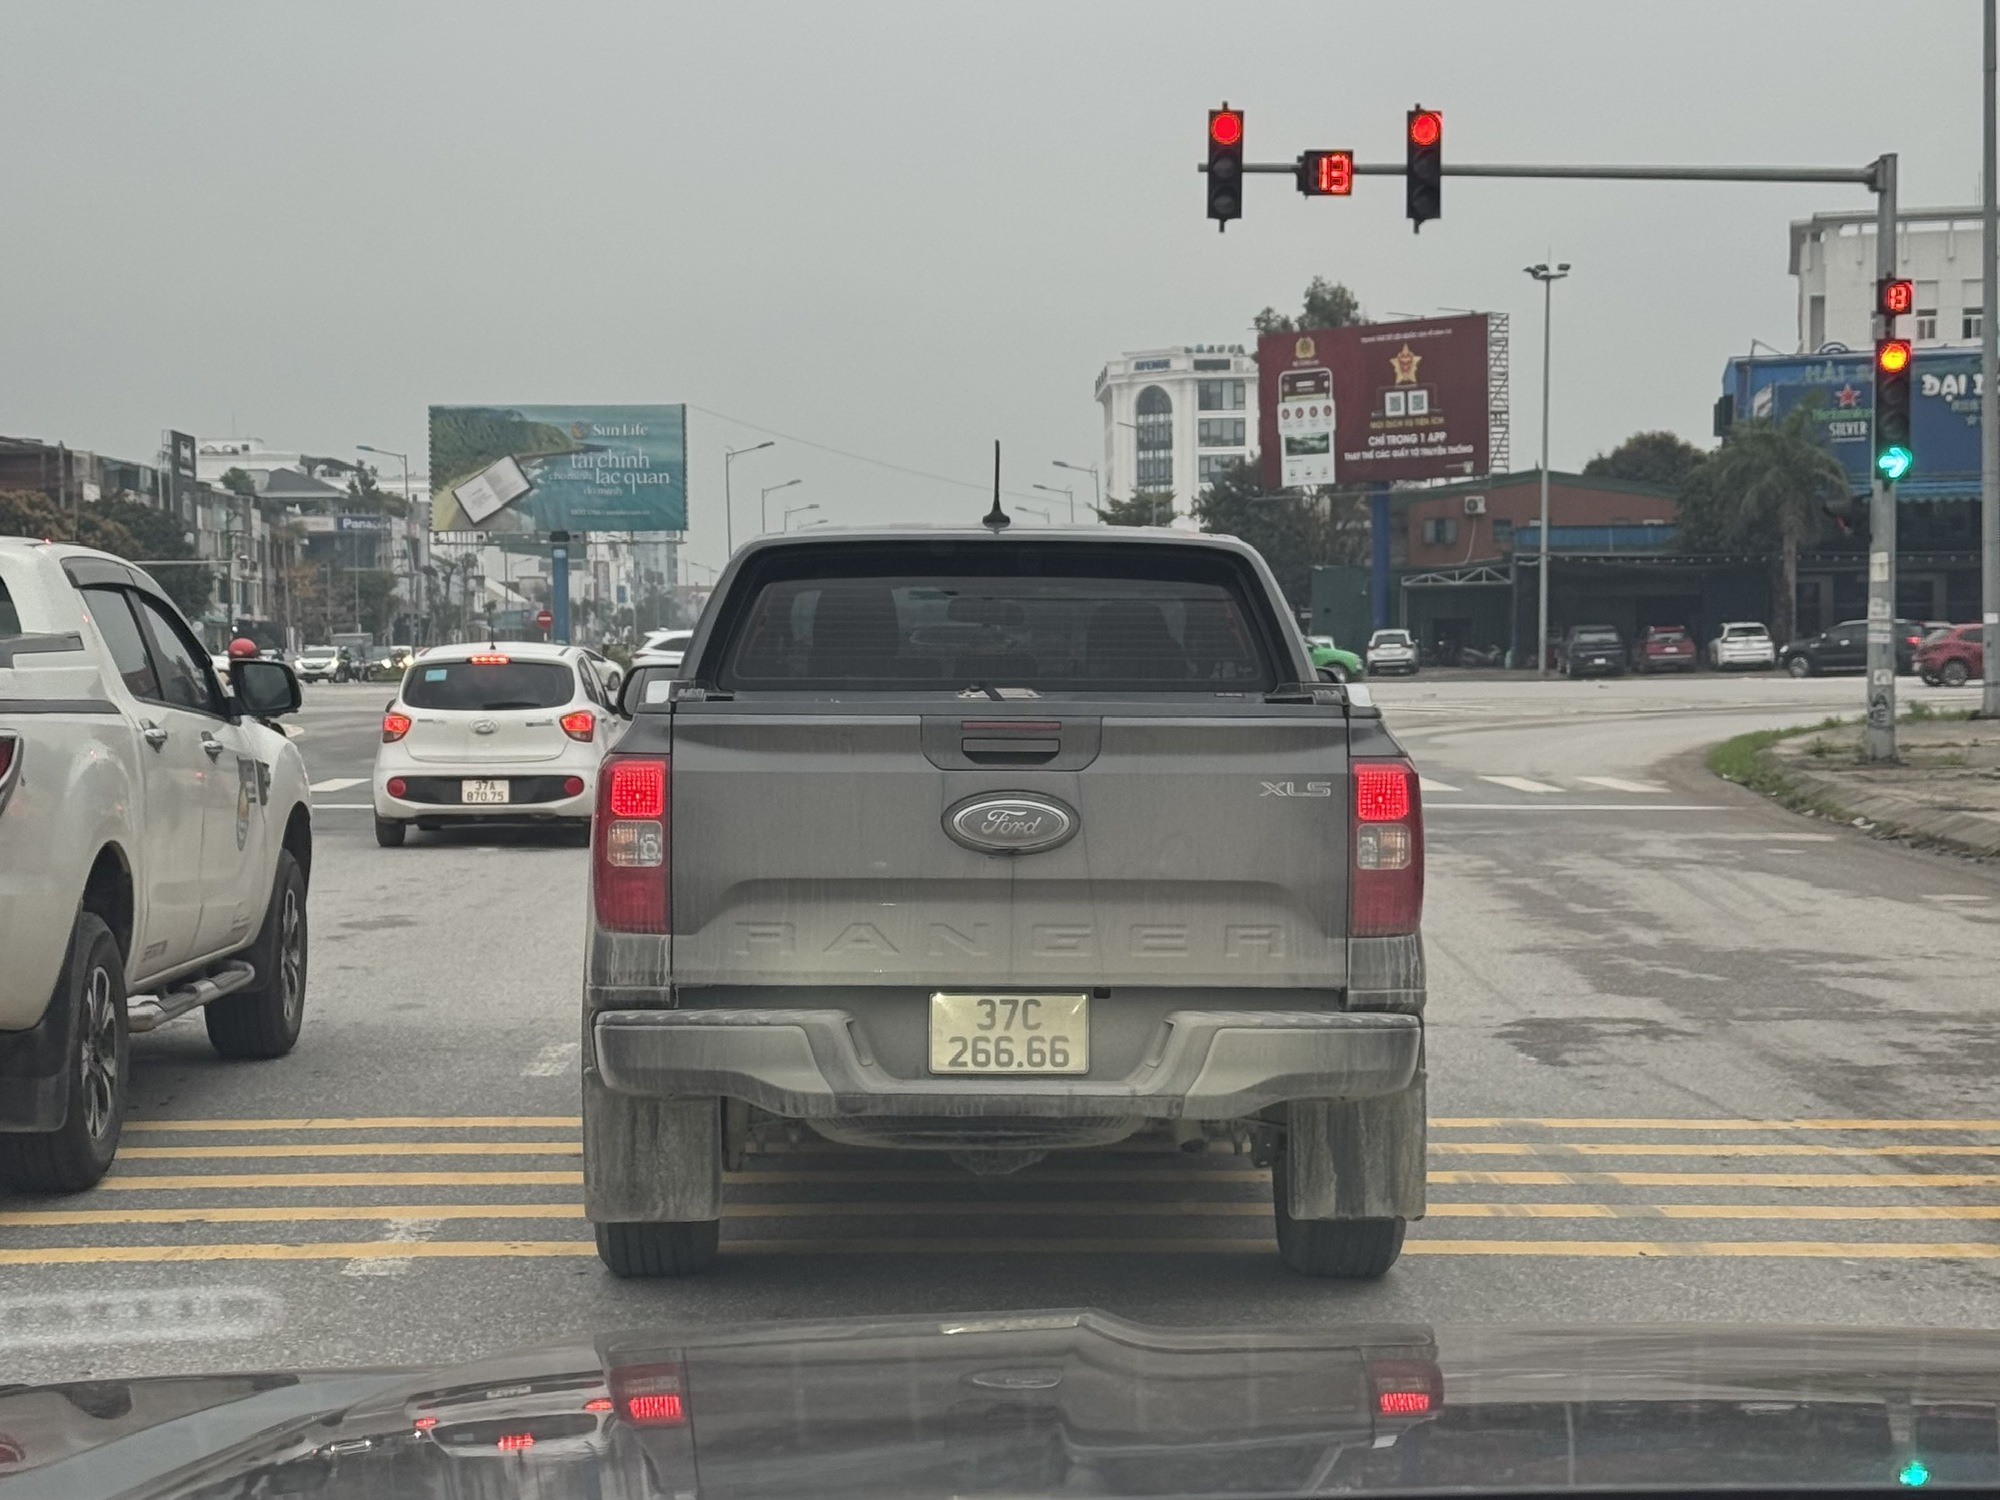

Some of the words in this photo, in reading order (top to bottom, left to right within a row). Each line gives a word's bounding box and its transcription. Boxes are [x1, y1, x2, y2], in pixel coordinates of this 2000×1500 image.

[1319, 153, 1350, 193] 13
[1890, 285, 1907, 310] 13
[1921, 373, 1967, 402] ĐẠI
[593, 423, 620, 436] Sun
[623, 422, 648, 436] Life
[1386, 433, 1418, 445] TRONG
[1420, 433, 1426, 443] 1
[1427, 431, 1448, 442] APP
[1829, 421, 1868, 436] SILVER
[624, 471, 670, 495] quan
[466, 791, 504, 801] 870.75
[475, 781, 496, 791] 37A
[1260, 781, 1332, 797] XLS
[981, 809, 1042, 835] Ford
[735, 921, 1285, 957] RANGER
[976, 999, 1042, 1031] 37C
[948, 1035, 1070, 1068] 266.66
